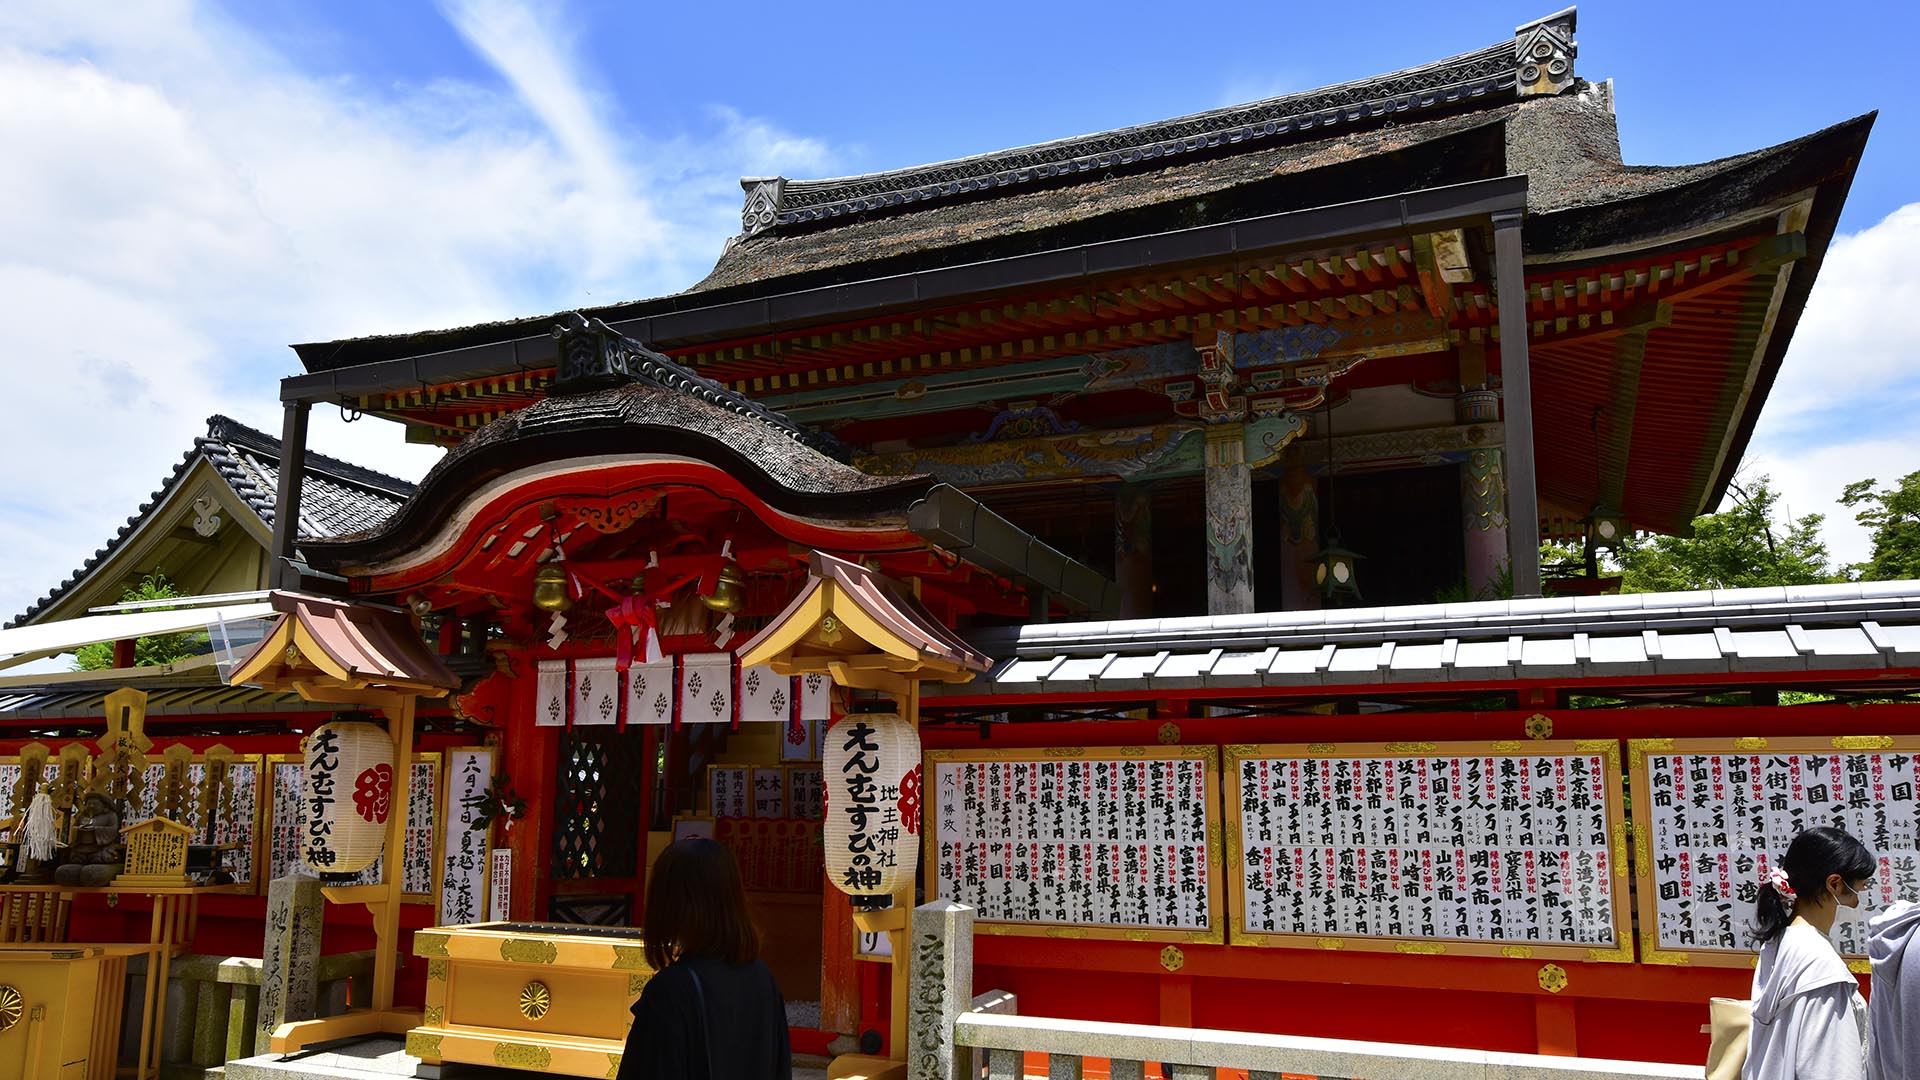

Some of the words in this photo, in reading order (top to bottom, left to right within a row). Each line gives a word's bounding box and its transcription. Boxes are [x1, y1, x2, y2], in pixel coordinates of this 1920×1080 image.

[306, 729, 339, 867] えんむすびの神
[964, 763, 977, 811] 奈良市
[1013, 764, 1027, 804] 神戸市
[1041, 762, 1055, 809] 岡山県
[1067, 762, 1081, 808] 東京都
[1149, 761, 1165, 808] 富士市
[1242, 761, 1259, 813] 東京都
[1272, 761, 1287, 807] 守山市
[1301, 759, 1320, 807] 東京都
[1334, 760, 1352, 811] 京都市
[1366, 760, 1382, 809] 京都市
[1431, 759, 1449, 817] 中国北京
[1466, 758, 1484, 809] フランス
[1500, 758, 1519, 811] 東京都
[1535, 758, 1554, 809] 台湾
[1569, 757, 1590, 810] 東京都
[1653, 757, 1672, 807] 日向市
[1765, 757, 1790, 811] 八街市
[1806, 754, 1828, 803] 中国
[1846, 754, 1870, 809] 福岡県
[1888, 754, 1912, 801] 中国
[843, 723, 881, 889] えんむすびの神
[876, 785, 899, 867] 地主神社
[975, 801, 986, 839] 五千円
[1001, 801, 1011, 838] 五千円
[1027, 802, 1038, 839] 五千円
[1053, 801, 1064, 839] 五千円
[1079, 800, 1091, 839] 五千円
[1107, 801, 1119, 840] 五千円
[1135, 801, 1146, 840] 五千円
[1163, 801, 1175, 840] 五千円
[1191, 802, 1204, 842] 五千円
[1258, 801, 1271, 841] 五千円
[1288, 803, 1300, 844] 五千円
[1320, 801, 1333, 845] 五千円
[1352, 804, 1365, 845] 一万円
[1383, 807, 1397, 845] 一万円
[1417, 803, 1430, 843] 一万円
[1451, 805, 1465, 847] 一万円
[1484, 803, 1498, 846] 一万円
[1519, 803, 1533, 846] 一万円
[1555, 805, 1569, 846] 一万円
[1590, 804, 1605, 845] 一万円
[1673, 805, 1689, 847] 一万円
[1712, 805, 1728, 847] 一万円
[1749, 805, 1766, 850] 一万円
[940, 842, 953, 880] 台湾
[964, 842, 978, 887] 千葉市
[990, 842, 1003, 879] 中国
[1015, 843, 1029, 882] 台湾
[1042, 844, 1055, 888] 京都市
[1068, 844, 1082, 893] 東京都
[1096, 844, 1111, 894] 奈良県
[1179, 845, 1195, 893] 富士市
[1245, 846, 1265, 892] 香港
[1276, 848, 1294, 897] 長野県
[1308, 848, 1322, 898] イスラエル
[1370, 849, 1388, 903] 高知県
[1402, 849, 1422, 897] 川崎市
[1436, 850, 1455, 901] 山形市
[1469, 850, 1489, 905] 明石市
[1537, 851, 1560, 908] 松江市
[1657, 854, 1680, 900] 中国
[1696, 854, 1718, 902] 香港
[1735, 854, 1759, 904] 台湾
[976, 881, 987, 918] 五千円
[1003, 881, 1013, 919] 五千円
[1028, 882, 1040, 920] 五千円
[1055, 883, 1066, 920] 五千円
[1082, 883, 1093, 921] 五千円
[1108, 883, 1121, 924] 五千円
[1137, 885, 1149, 924] 五千円
[1166, 885, 1178, 926] 五千円
[1195, 885, 1207, 927] 五千円
[1261, 887, 1274, 931] 五千円
[1291, 891, 1305, 932] 五千円
[1323, 890, 1337, 932] 五千円
[1353, 891, 1368, 934] 六千円
[1388, 895, 1401, 935] 一万円
[1421, 896, 1434, 936] 一万円
[1455, 897, 1469, 937] 一万円
[1490, 898, 1504, 939] 一万円
[1525, 897, 1539, 940] 一万円
[1560, 900, 1575, 941] 一万円
[1597, 899, 1612, 943] 一万円
[1678, 901, 1695, 944] 一万円
[1716, 904, 1736, 948] 一万円
[1839, 922, 1856, 954] 万円
